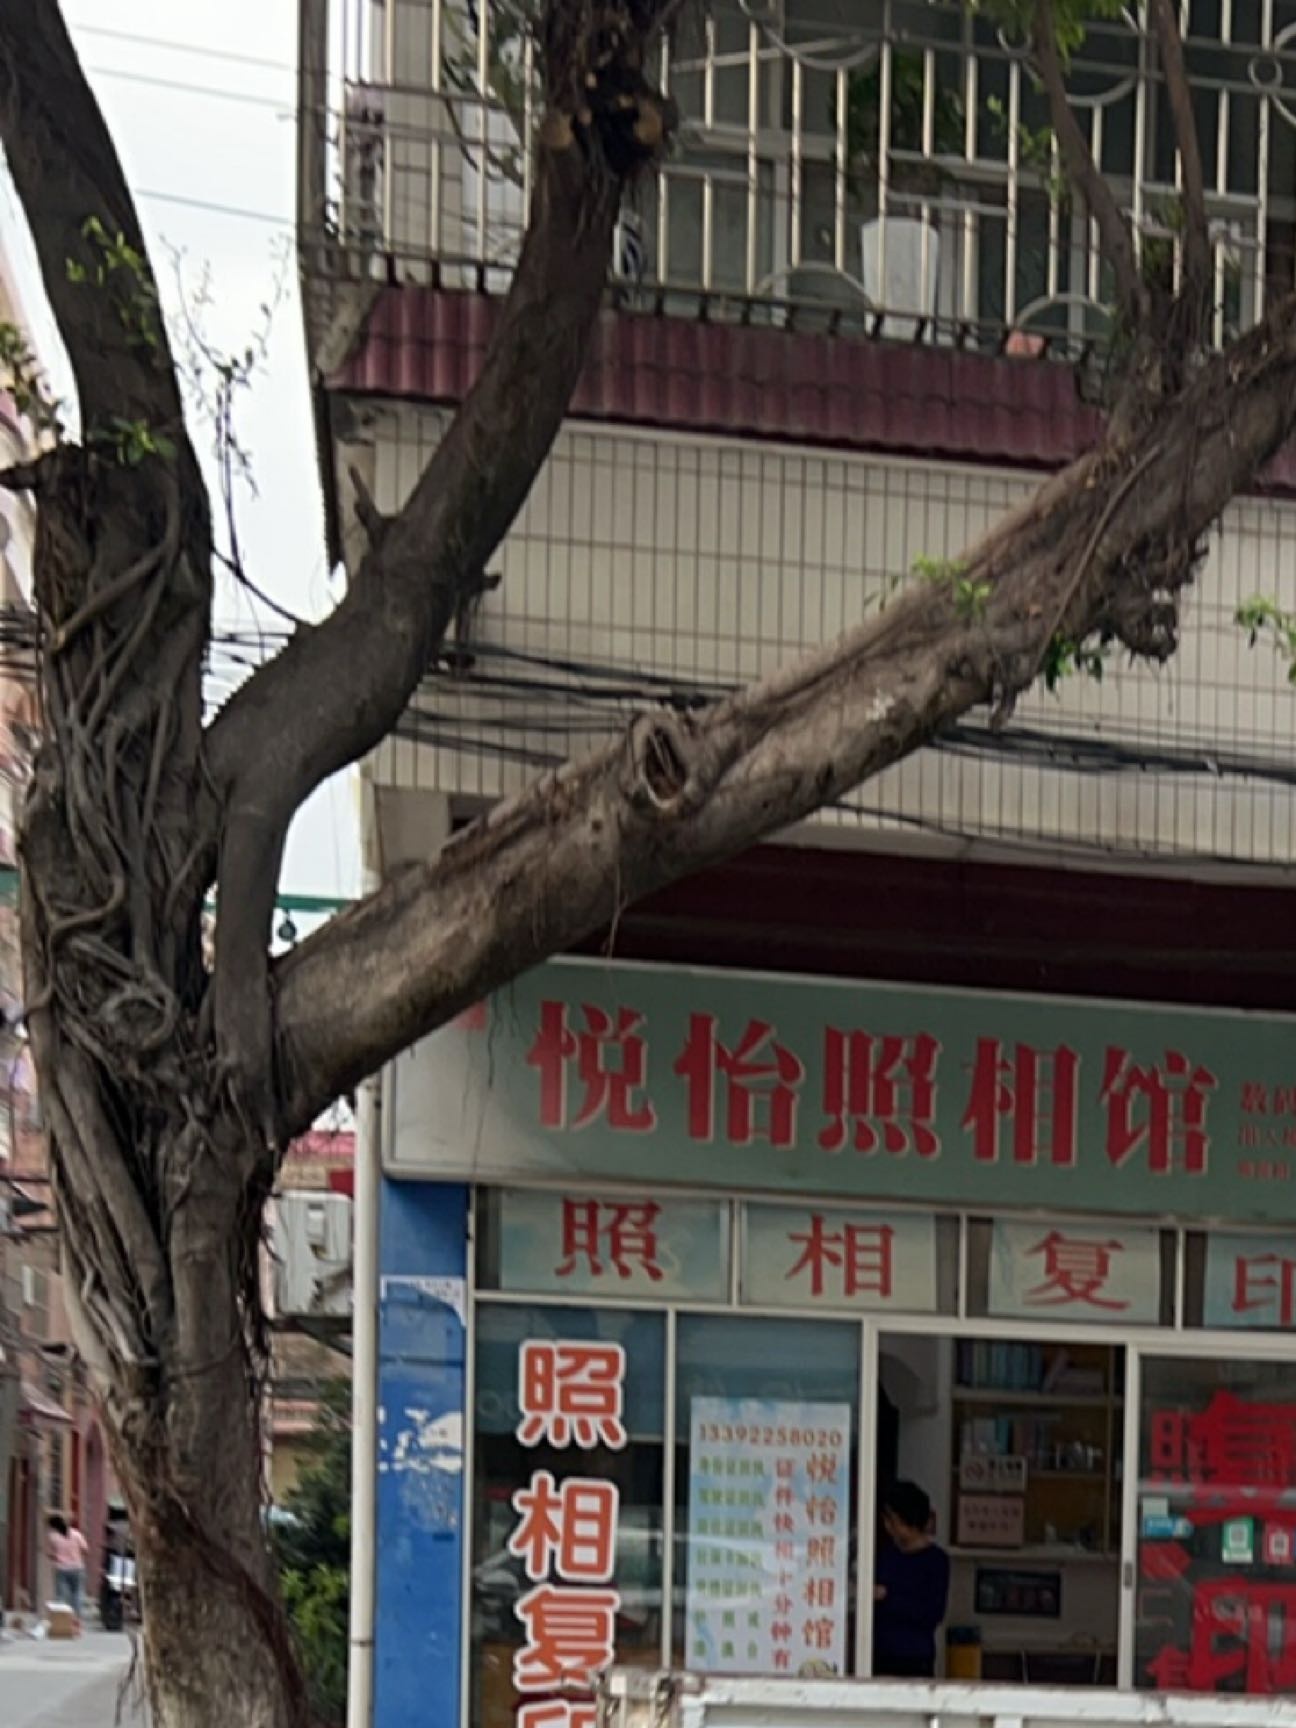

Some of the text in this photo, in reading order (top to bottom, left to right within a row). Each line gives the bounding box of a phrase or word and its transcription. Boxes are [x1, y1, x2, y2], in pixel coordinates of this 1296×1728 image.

[525, 1000, 1218, 1177] 悦怡照相馆
[699, 1423, 843, 1447] 13392258020
[803, 1452, 838, 1650] 悦怡照相馆
